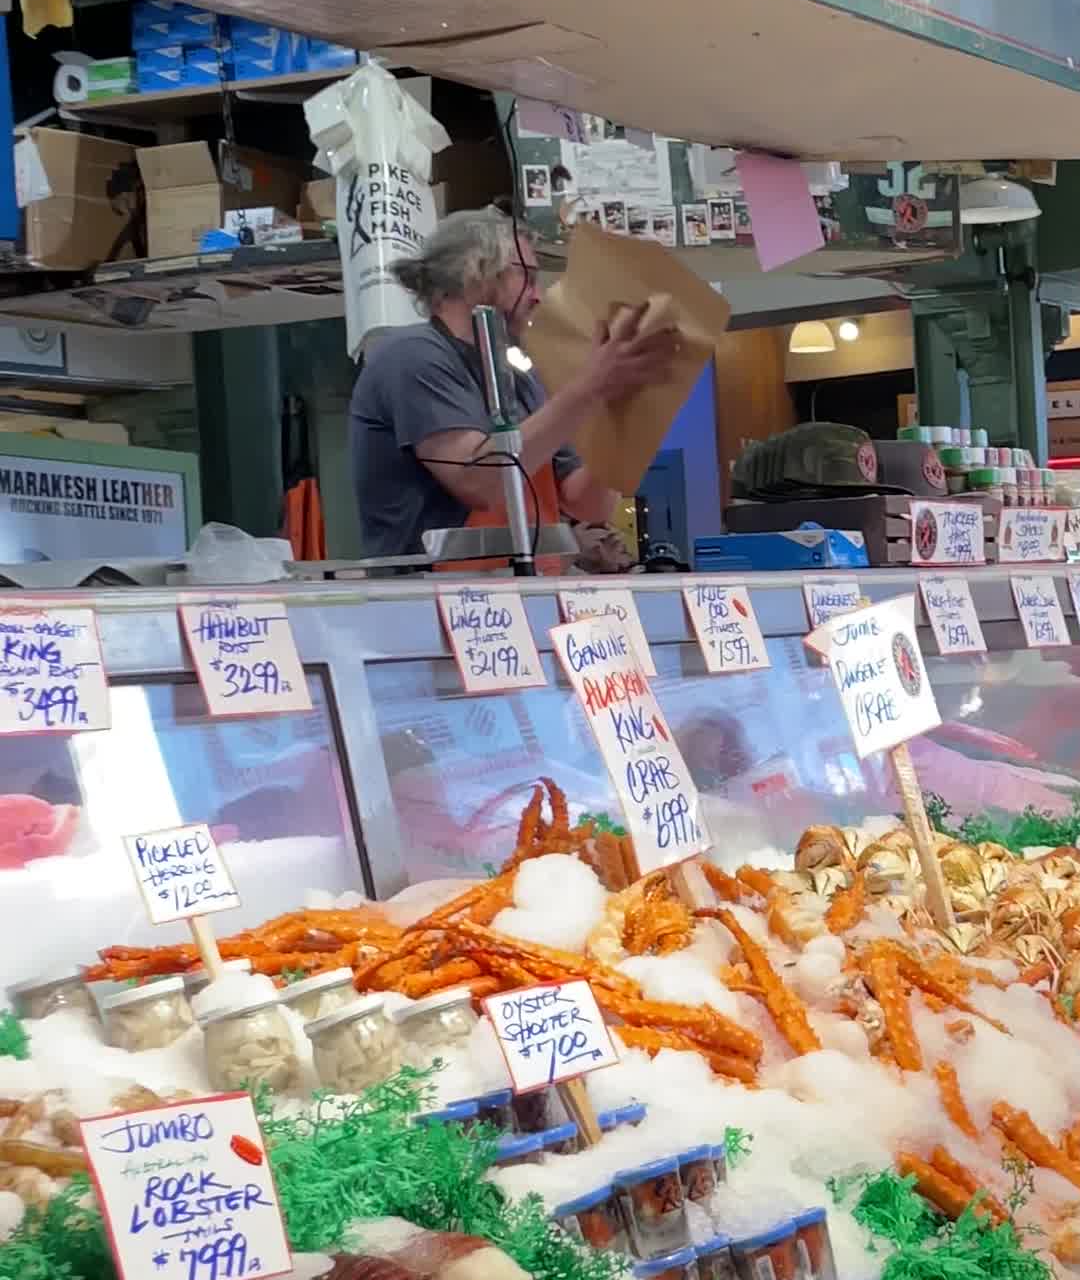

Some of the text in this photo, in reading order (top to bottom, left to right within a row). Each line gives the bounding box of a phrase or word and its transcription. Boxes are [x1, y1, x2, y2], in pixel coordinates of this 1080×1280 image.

[369, 181, 422, 213] PLACE
[370, 200, 411, 222] FISH
[102, 478, 174, 509] LEATHER
[63, 502, 107, 520] SEATTLE
[109, 506, 139, 522] SINCE
[192, 611, 288, 643] HALIBUT
[2, 635, 61, 663] KING
[567, 633, 627, 673] GENUINE
[625, 756, 681, 804] CRAB
[501, 986, 577, 1022] OYSTER
[498, 1007, 593, 1045] SHOOTER
[101, 1112, 214, 1153] JUMBO
[144, 1170, 233, 1208] ROCK
[129, 1183, 273, 1234] LOBSTER
